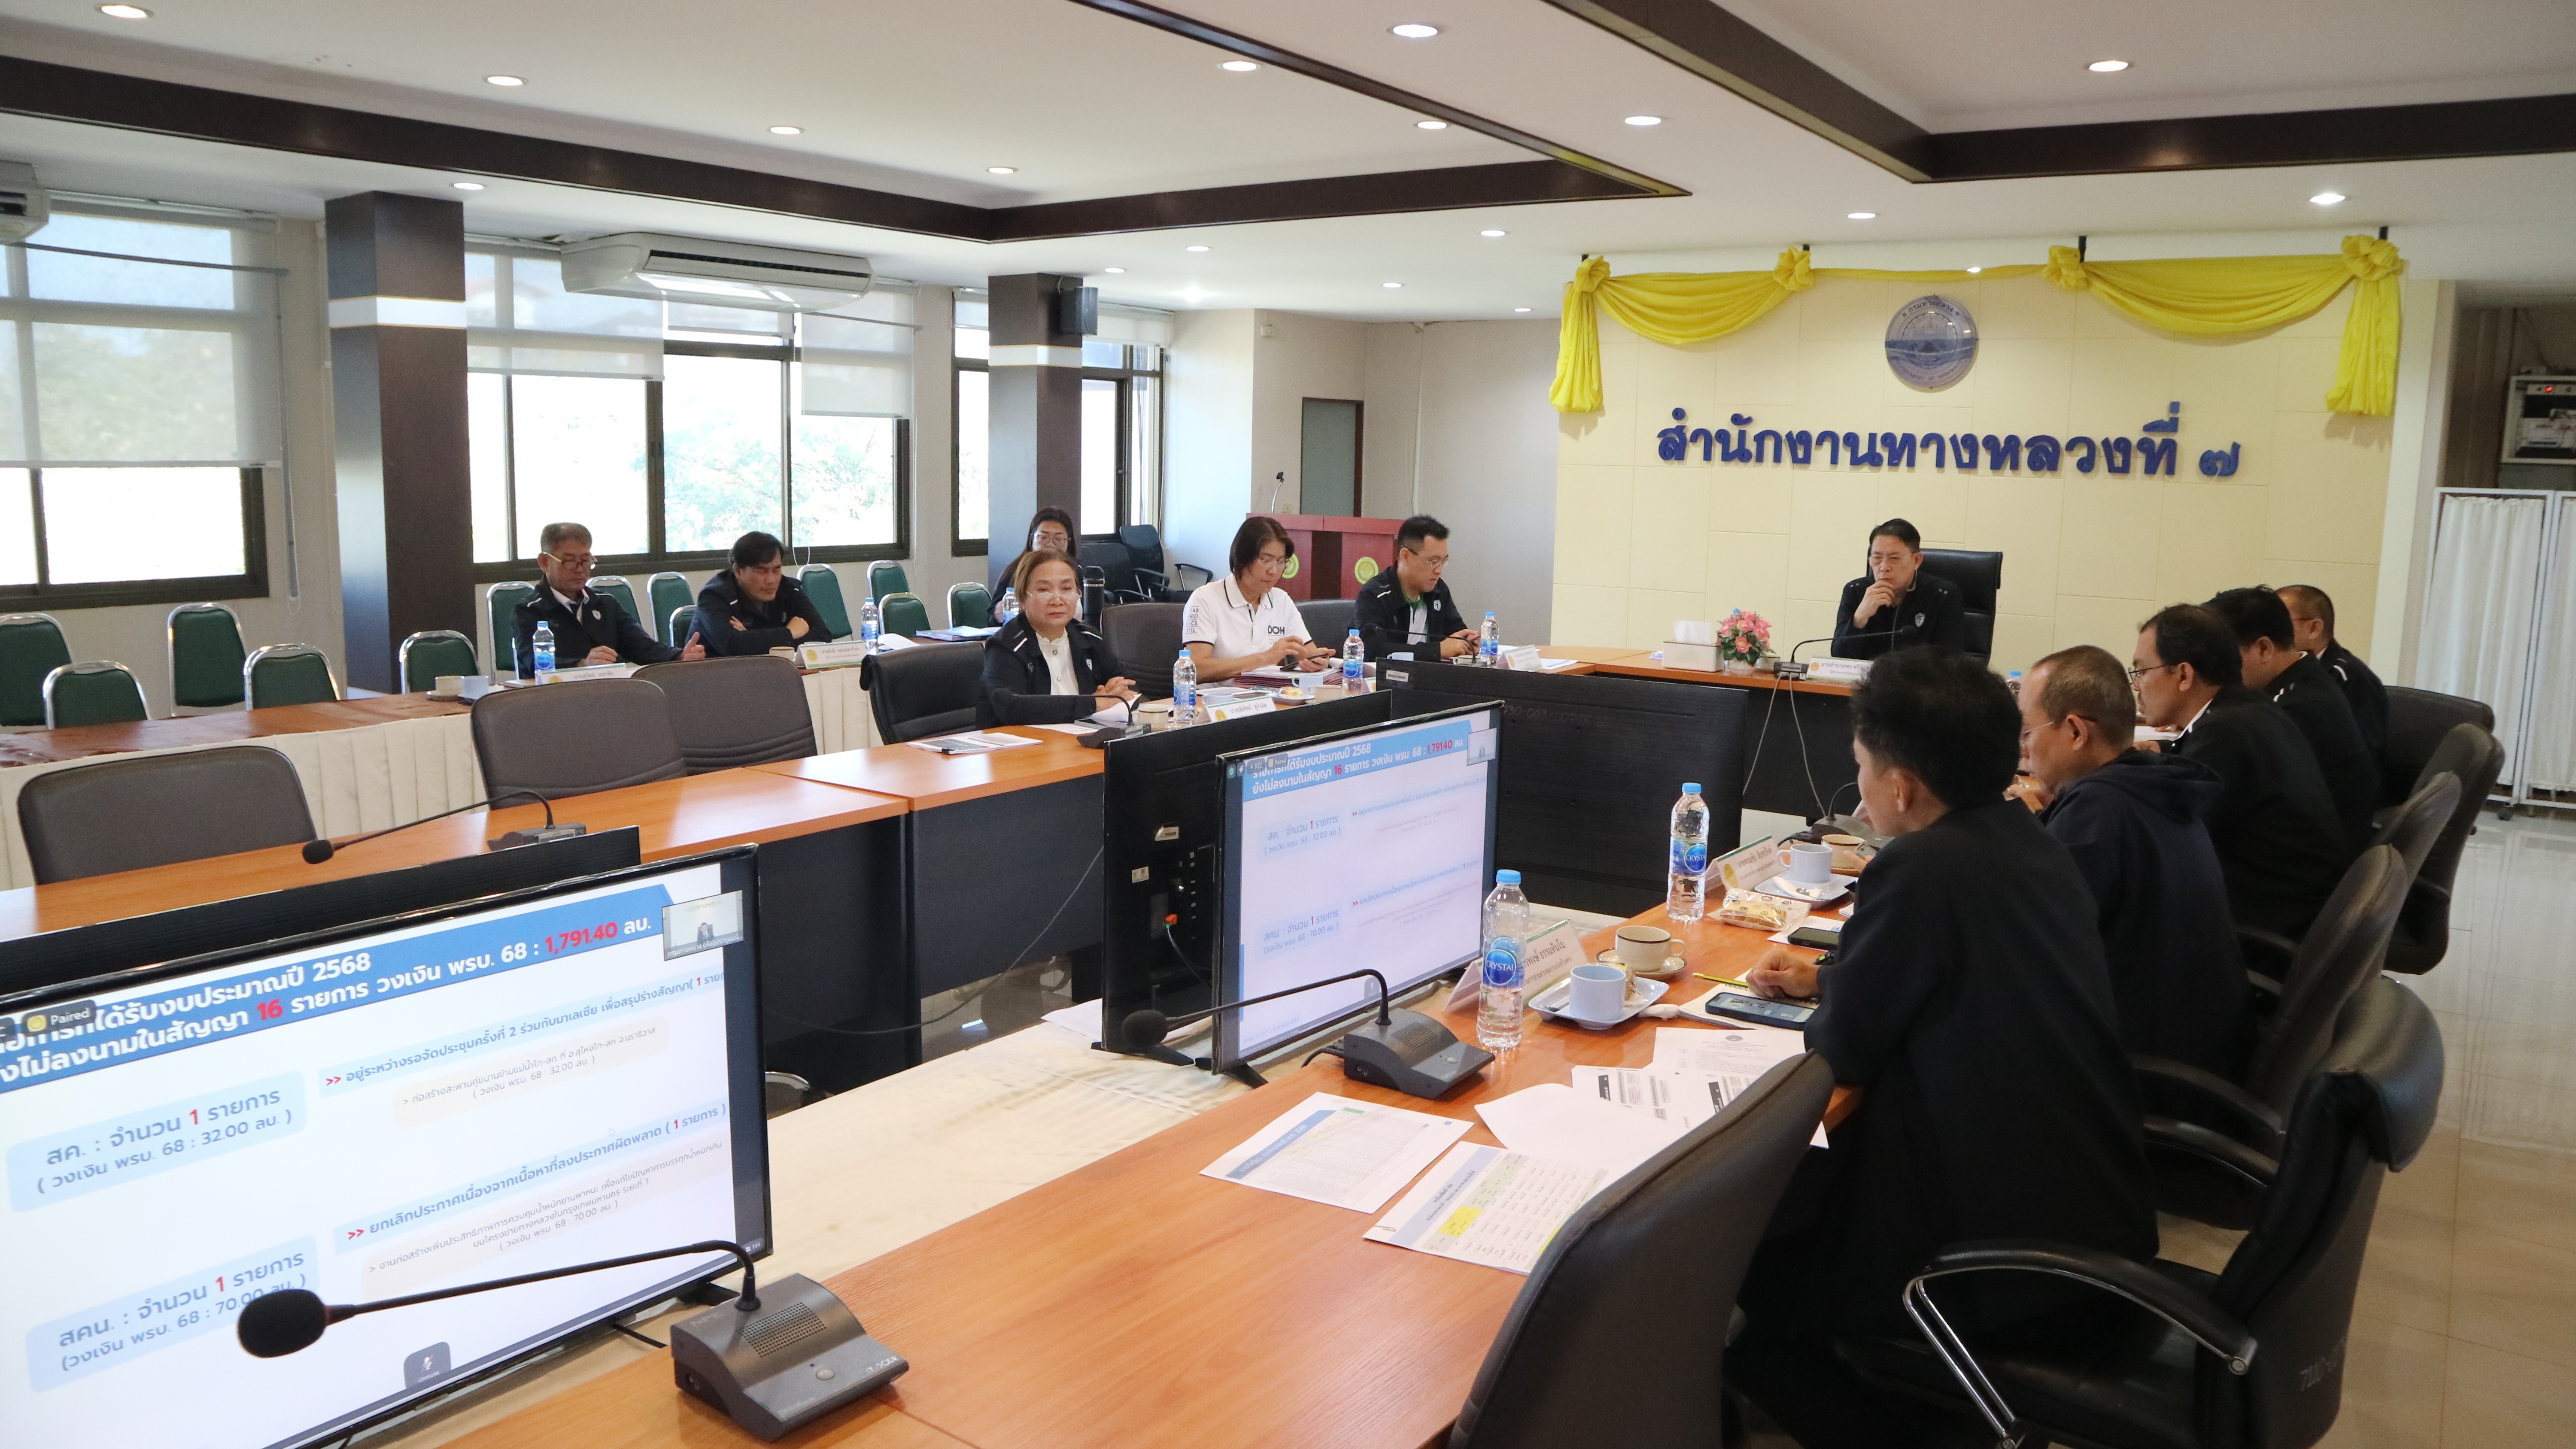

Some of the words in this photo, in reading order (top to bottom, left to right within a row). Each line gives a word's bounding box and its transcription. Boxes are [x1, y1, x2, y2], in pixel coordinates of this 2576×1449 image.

[1656, 400, 2180, 476] สำนักงานทางหลวงที่
[2198, 440, 2241, 477] ๗
[1267, 625, 1285, 635] DOH
[1274, 757, 1286, 765] Paired
[1334, 764, 1343, 776] 16
[1344, 758, 1369, 773] รายการ
[1371, 753, 1393, 767] วงเงิน
[1395, 750, 1410, 761] พรบ.
[1412, 746, 1421, 757] 68
[1352, 743, 1371, 757] 2568
[1286, 823, 1308, 837] จำนวน
[1309, 820, 1314, 829] 1
[1315, 815, 1338, 829] รายการ
[1300, 836, 1308, 844] 68
[1288, 920, 1308, 934] จำนวน
[1311, 916, 1314, 925] 1
[1316, 909, 1339, 924] รายการ
[1298, 934, 1305, 942] 68
[312, 952, 371, 982] 2568
[1486, 959, 1515, 972] CRYSTAL
[0, 1010, 249, 1082] งไม่ลงนามในสัญญา
[256, 998, 283, 1020] 16
[290, 982, 369, 1013] รายการ
[376, 964, 442, 993] วงเงิน
[448, 952, 495, 976] พรบ.
[500, 941, 528, 964] 68
[533, 943, 539, 956] :
[544, 921, 618, 955] 1,791.40
[623, 916, 652, 935] ลบ.
[50, 1008, 91, 1025] Paired
[346, 1025, 506, 1082] อยู่ระหว่างรอจัดประชุมครั้งที่
[509, 1026, 516, 1038] 2
[520, 1005, 598, 1035] ร่วมกับมาเลเซีย
[696, 977, 701, 986] 1
[480, 1082, 505, 1096] วงเงิน
[508, 1077, 528, 1087] พรบ.
[531, 1070, 542, 1080] 68
[550, 1062, 574, 1075] 32.00
[47, 1144, 86, 1165] สค.
[109, 1116, 181, 1148] จำนวน
[189, 1109, 199, 1125] 1
[207, 1090, 281, 1121] รายการ
[52, 1162, 107, 1188] วงเงิน
[115, 1150, 157, 1170] พรบ.
[162, 1140, 185, 1156] 68
[201, 1122, 249, 1146] 32.00
[255, 1114, 280, 1131] ลบ.
[369, 1126, 662, 1234] ยกเลิกประกาศเนื่องจากเนื้อหาที่ลงประกาศผิดพลาด
[673, 1119, 678, 1130] 1
[682, 1107, 718, 1127] รายการ
[623, 1178, 642, 1193] ระยะที่
[506, 1232, 531, 1247] วงเงิน
[555, 1219, 566, 1229] 68
[59, 1319, 115, 1347] สคน.
[138, 1285, 208, 1320] จำนวน
[215, 1276, 225, 1292] 1
[232, 1252, 304, 1288] รายการ
[62, 1338, 124, 1371] (วงเงิน
[131, 1325, 171, 1345] พรบ.
[176, 1310, 200, 1328] 68
[417, 1370, 440, 1383] Unmute
